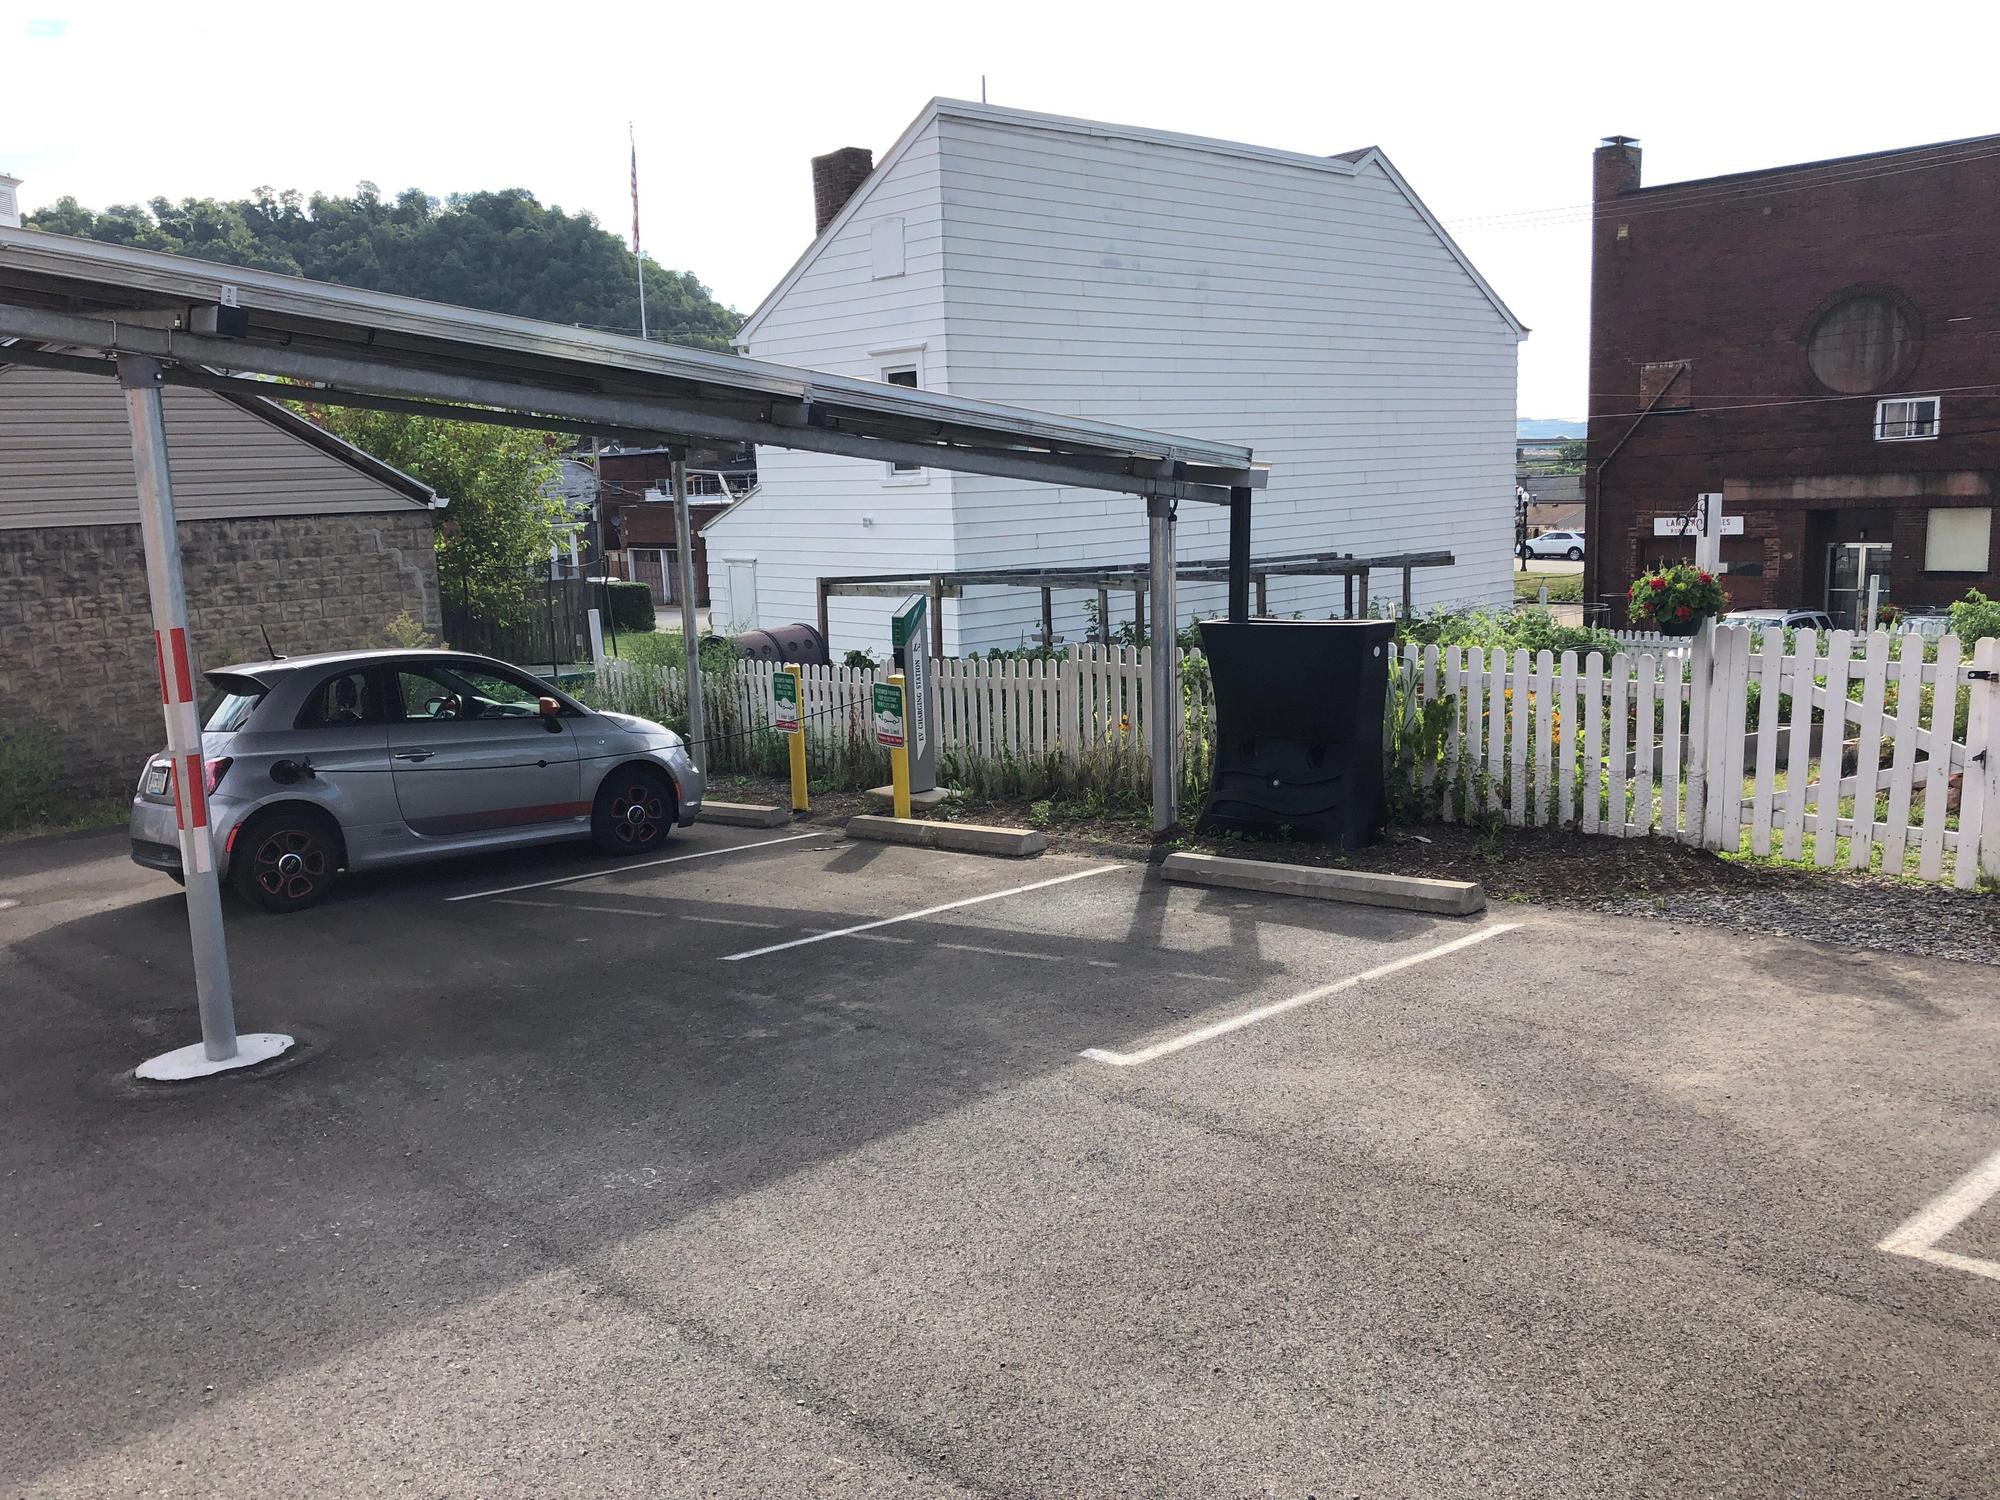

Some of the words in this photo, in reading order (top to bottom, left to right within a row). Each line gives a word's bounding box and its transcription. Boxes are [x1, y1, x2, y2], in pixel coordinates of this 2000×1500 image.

[1666, 519, 1696, 527] LAMBER
[916, 692, 924, 730] CHARGING
[918, 732, 924, 742] EV
